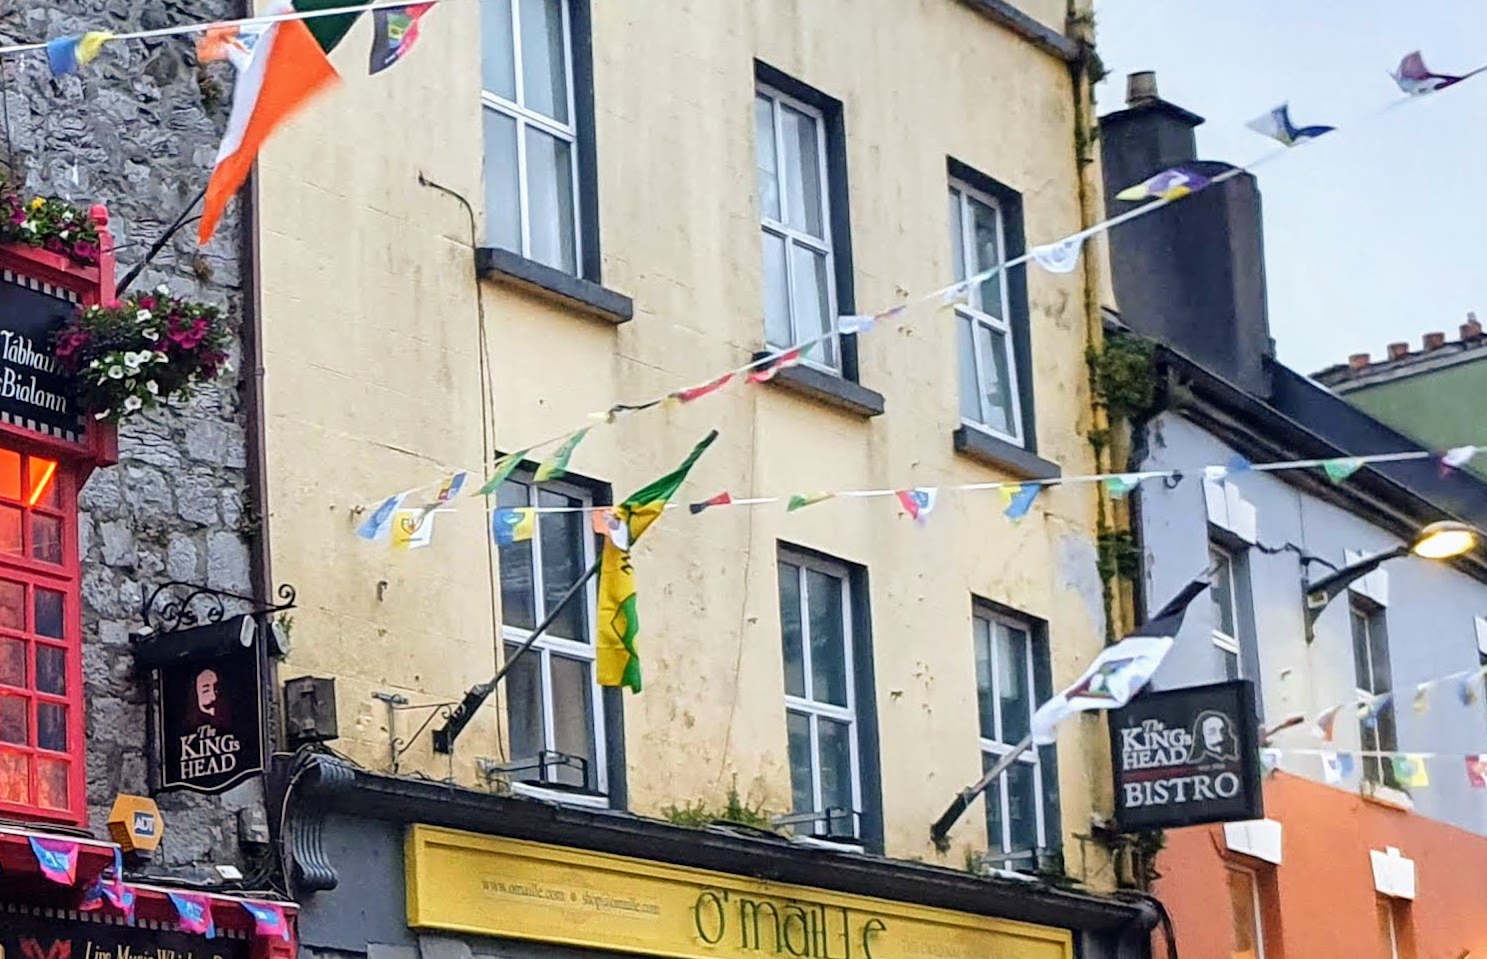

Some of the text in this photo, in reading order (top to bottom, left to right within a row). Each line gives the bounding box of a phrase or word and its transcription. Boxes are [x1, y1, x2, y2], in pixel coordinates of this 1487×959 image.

[180, 753, 237, 780] HEAD
[1122, 746, 1188, 770] HEAD
[1123, 771, 1240, 808] BISTRO
[134, 815, 154, 832] ADT
